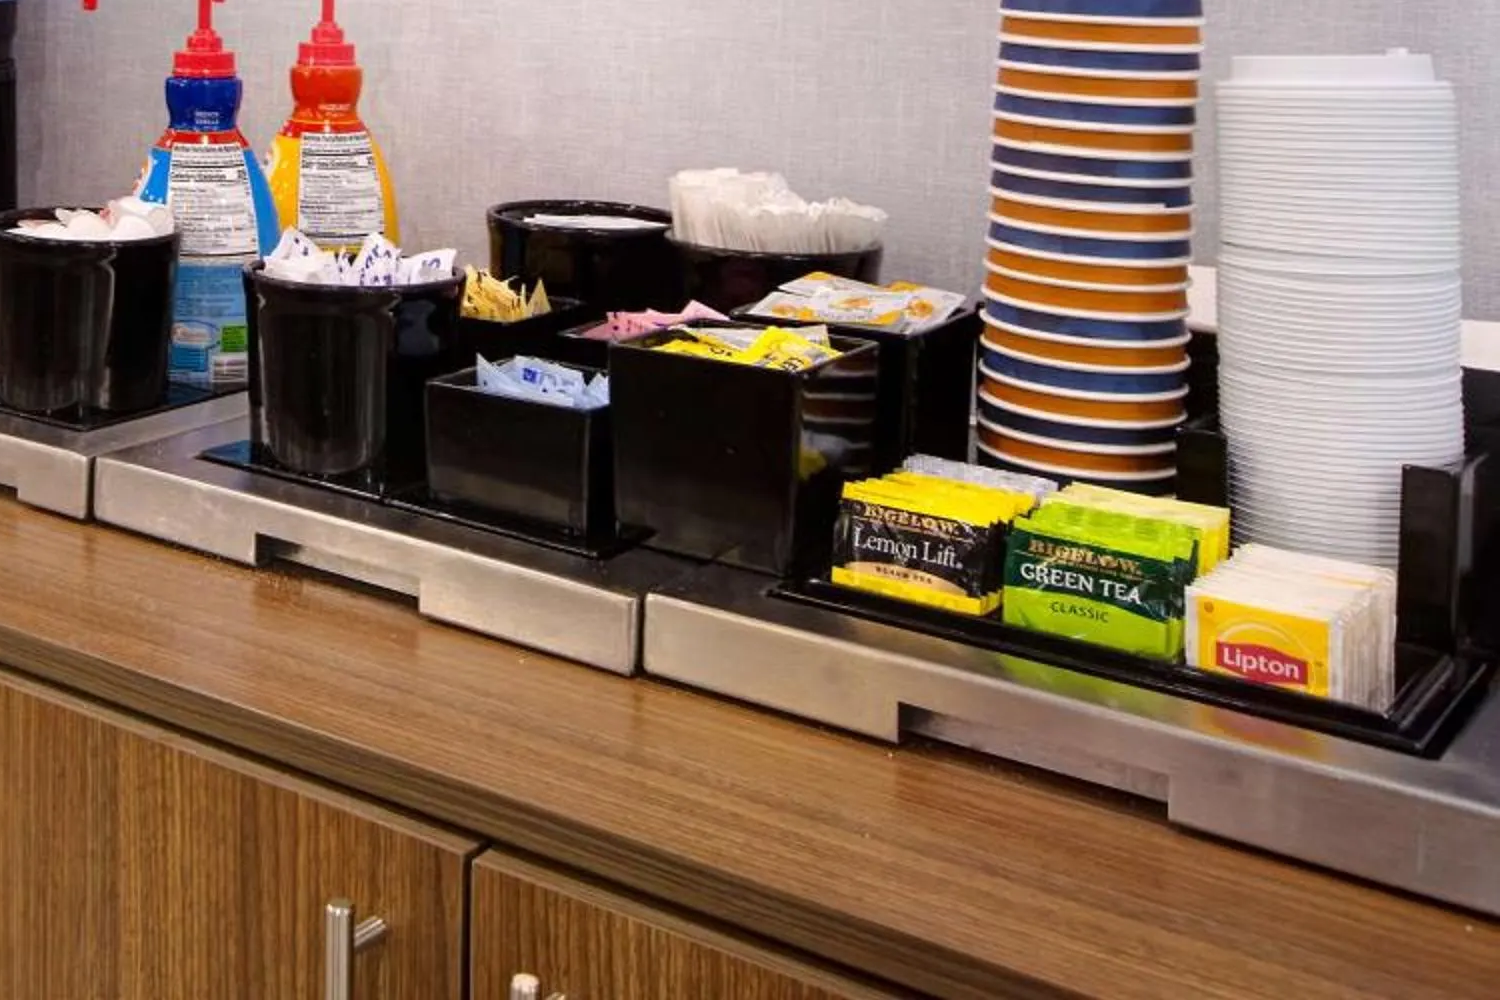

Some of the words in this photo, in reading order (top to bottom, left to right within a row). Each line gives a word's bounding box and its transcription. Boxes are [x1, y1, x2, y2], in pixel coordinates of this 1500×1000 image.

[853, 526, 918, 559] Lemon
[1020, 563, 1094, 593] GREEN
[1100, 579, 1142, 605] TEA
[1050, 601, 1109, 623] CLASSIC
[1223, 647, 1300, 679] Lipton
